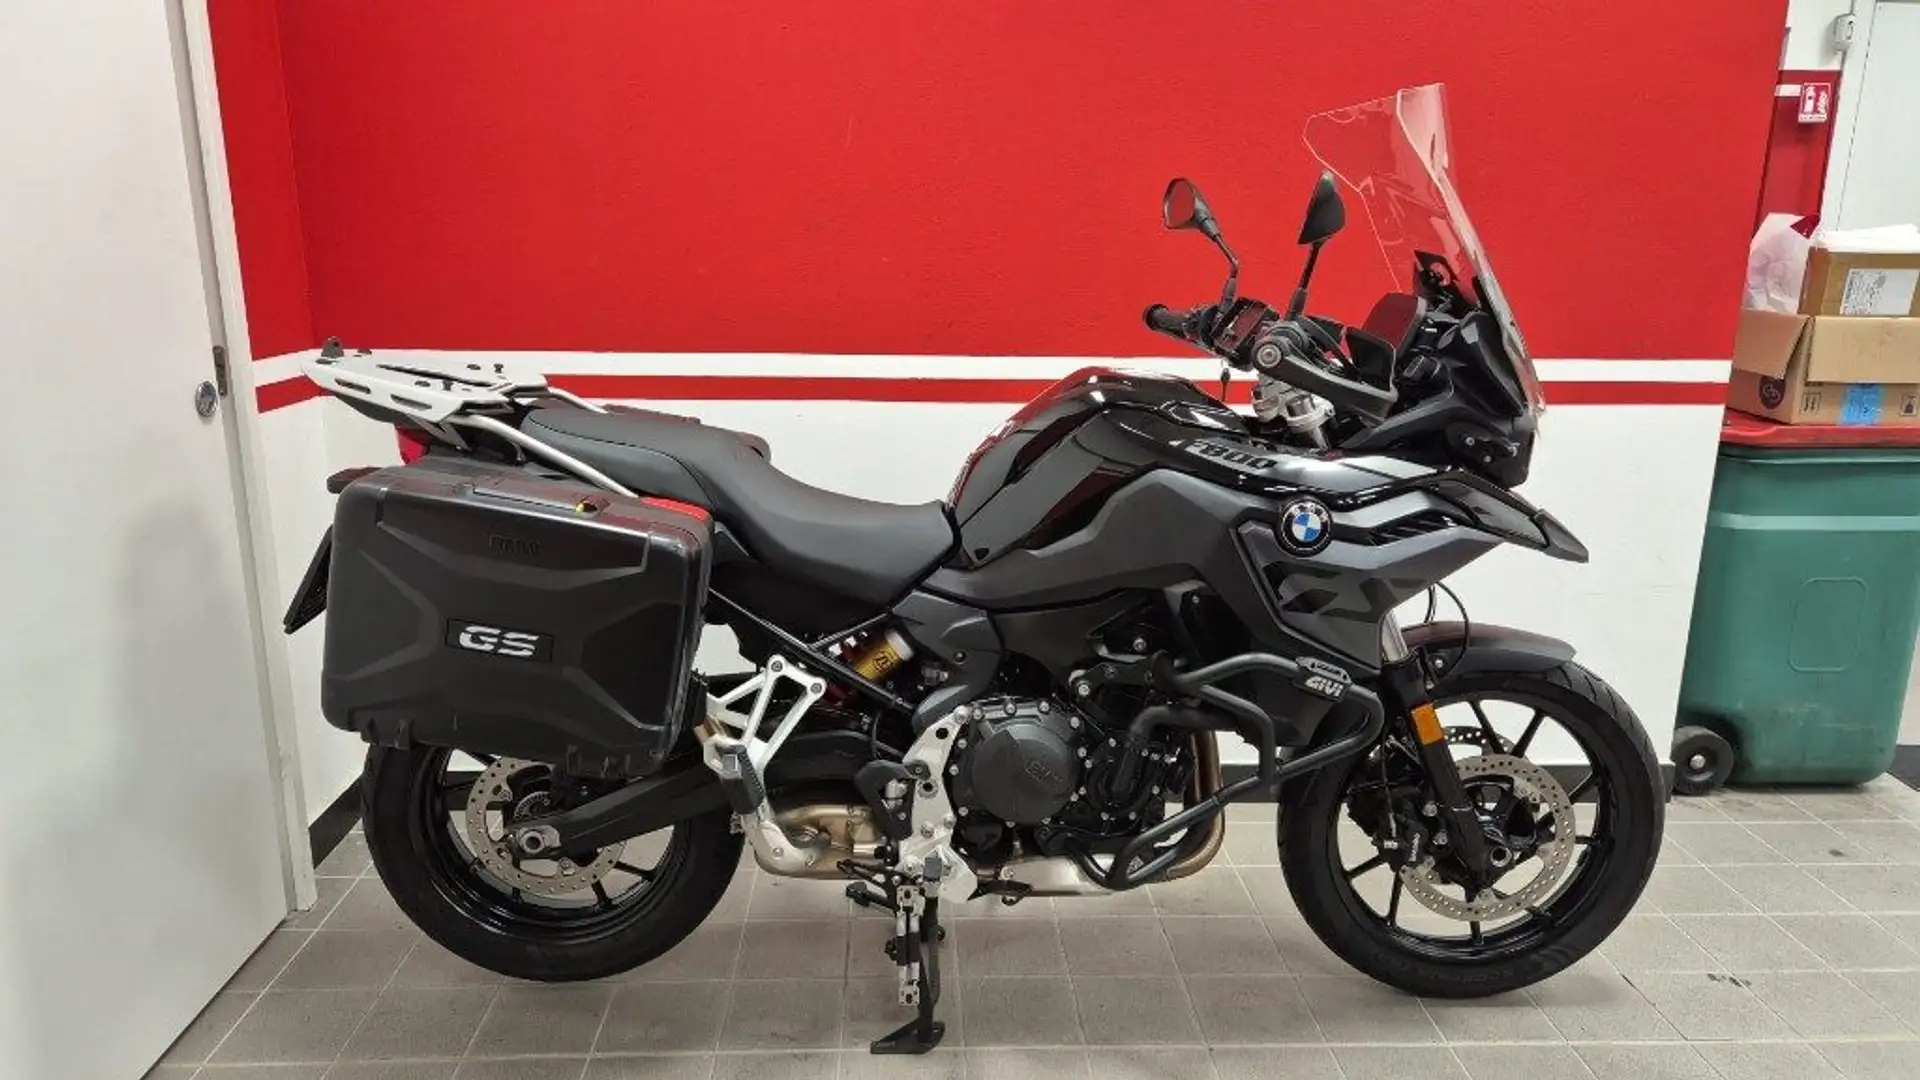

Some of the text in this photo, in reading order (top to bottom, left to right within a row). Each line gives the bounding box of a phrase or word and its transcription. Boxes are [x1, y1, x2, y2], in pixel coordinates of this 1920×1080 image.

[1288, 501, 1329, 523] BMW
[458, 625, 540, 657] GS
[1305, 675, 1344, 697] GIVI
